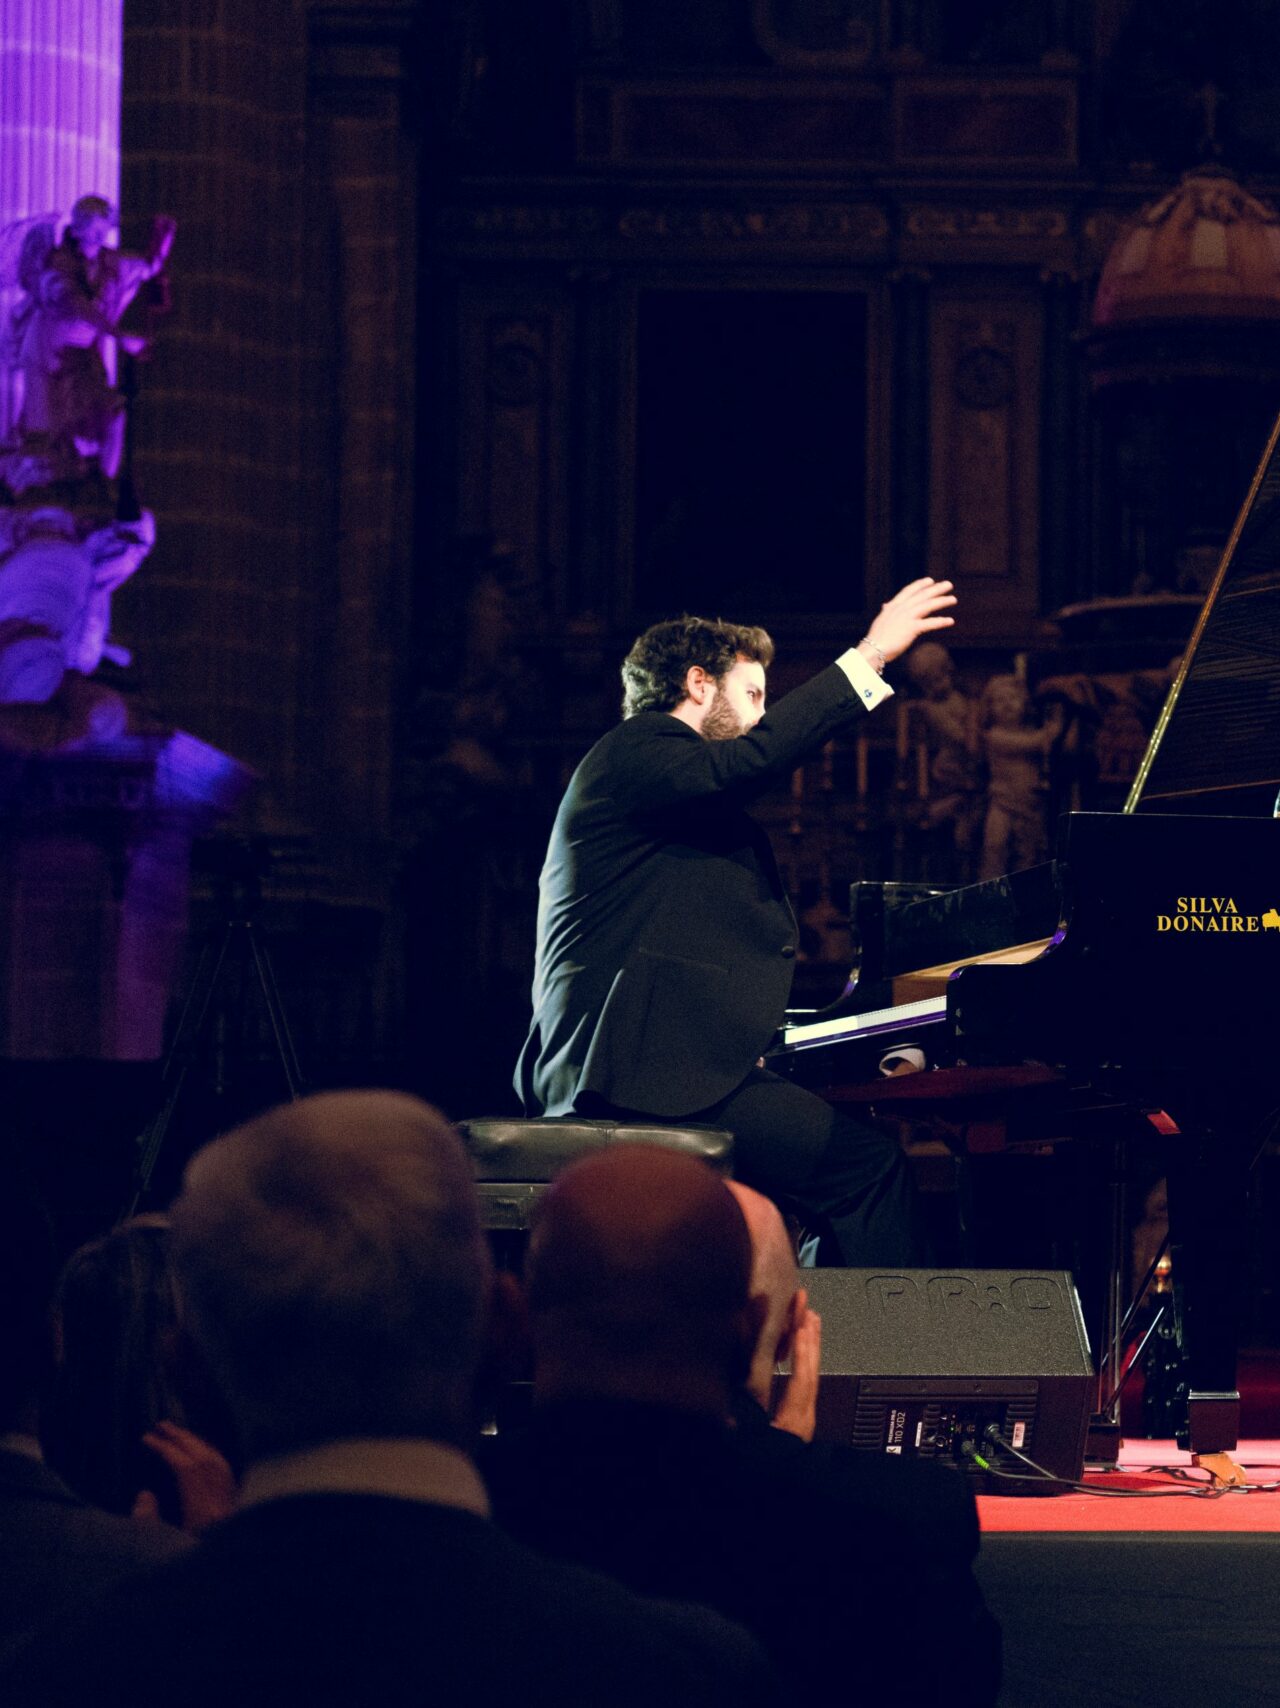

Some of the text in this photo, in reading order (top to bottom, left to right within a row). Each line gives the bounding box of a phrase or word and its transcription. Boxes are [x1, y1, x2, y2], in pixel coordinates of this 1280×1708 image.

[1177, 897, 1238, 914] SILVA
[1157, 915, 1259, 932] DONAIRE
[896, 1412, 906, 1429] XD2
[894, 1430, 904, 1443] 110
